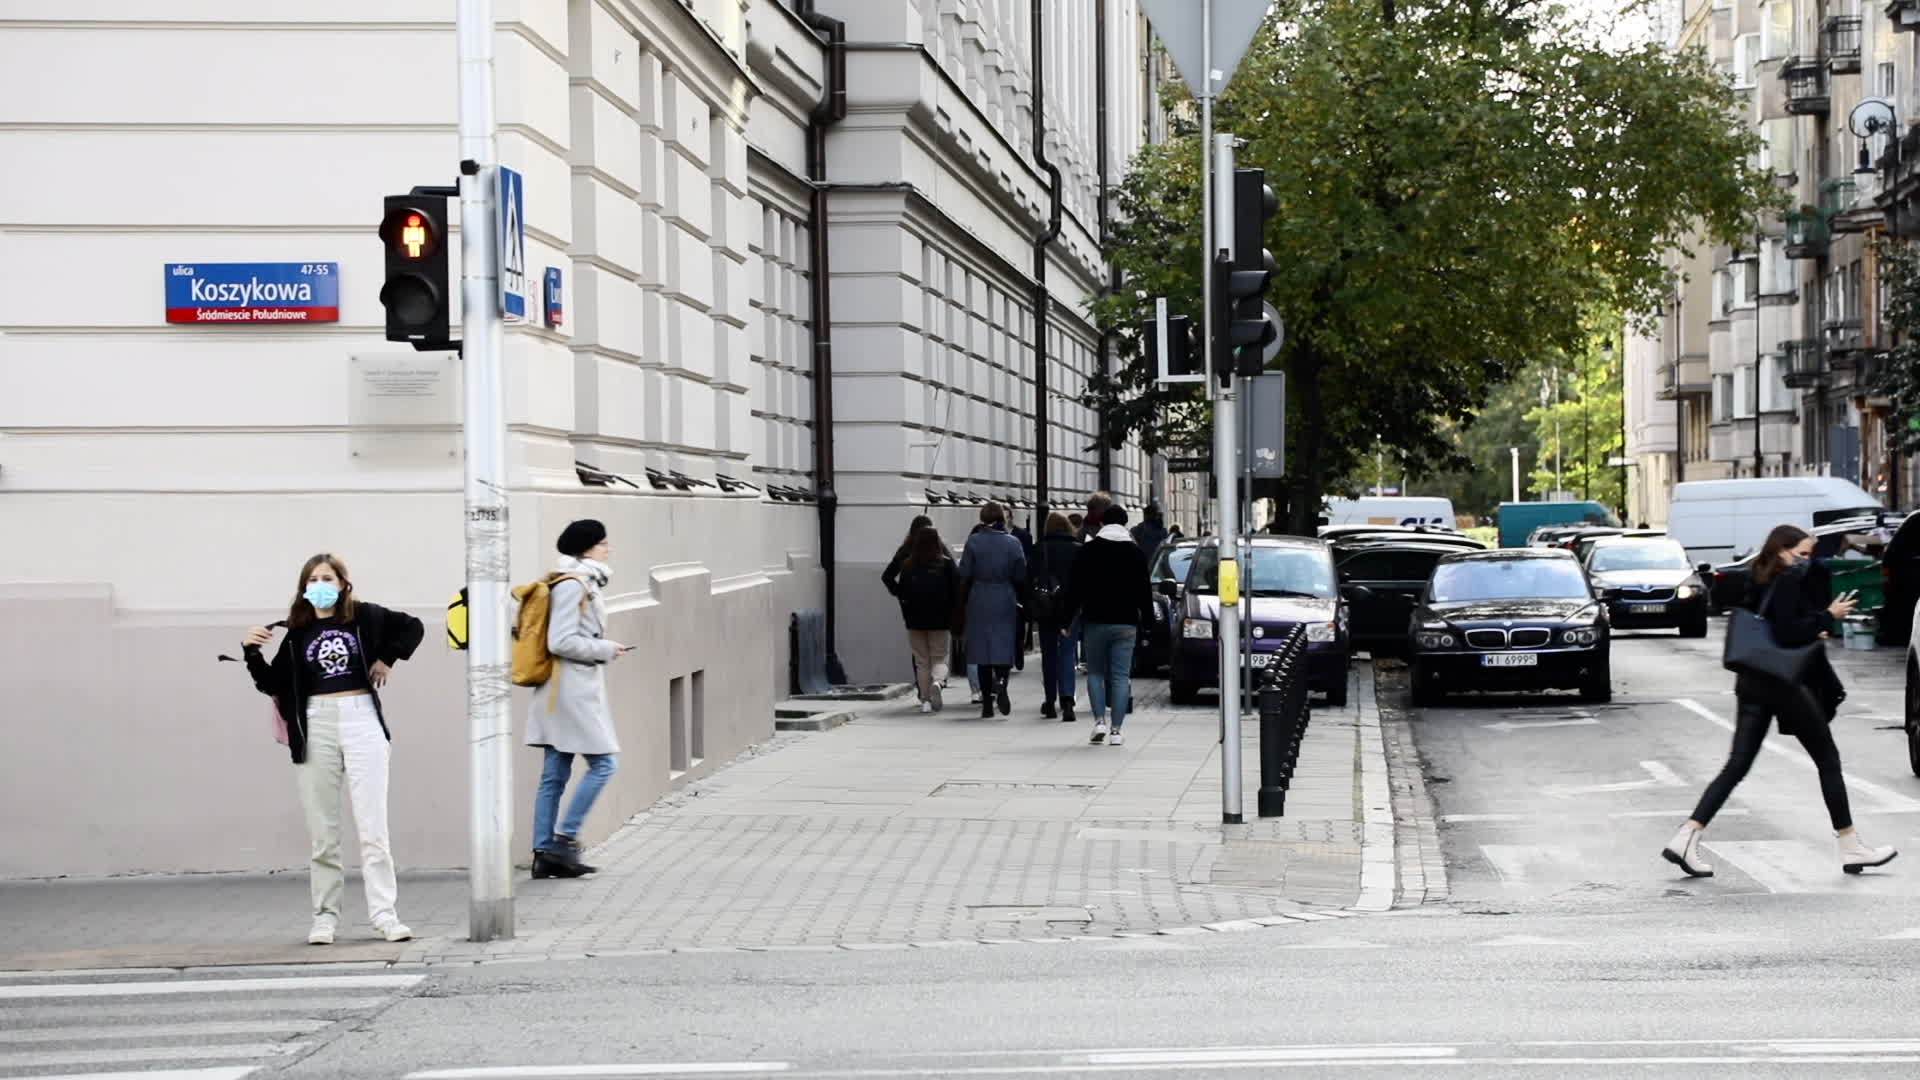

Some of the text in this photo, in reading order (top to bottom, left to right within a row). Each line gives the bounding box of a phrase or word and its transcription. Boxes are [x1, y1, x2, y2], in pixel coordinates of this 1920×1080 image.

[173, 265, 194, 276] ulica
[301, 264, 328, 275] 47-55
[191, 277, 311, 307] Koszykowa
